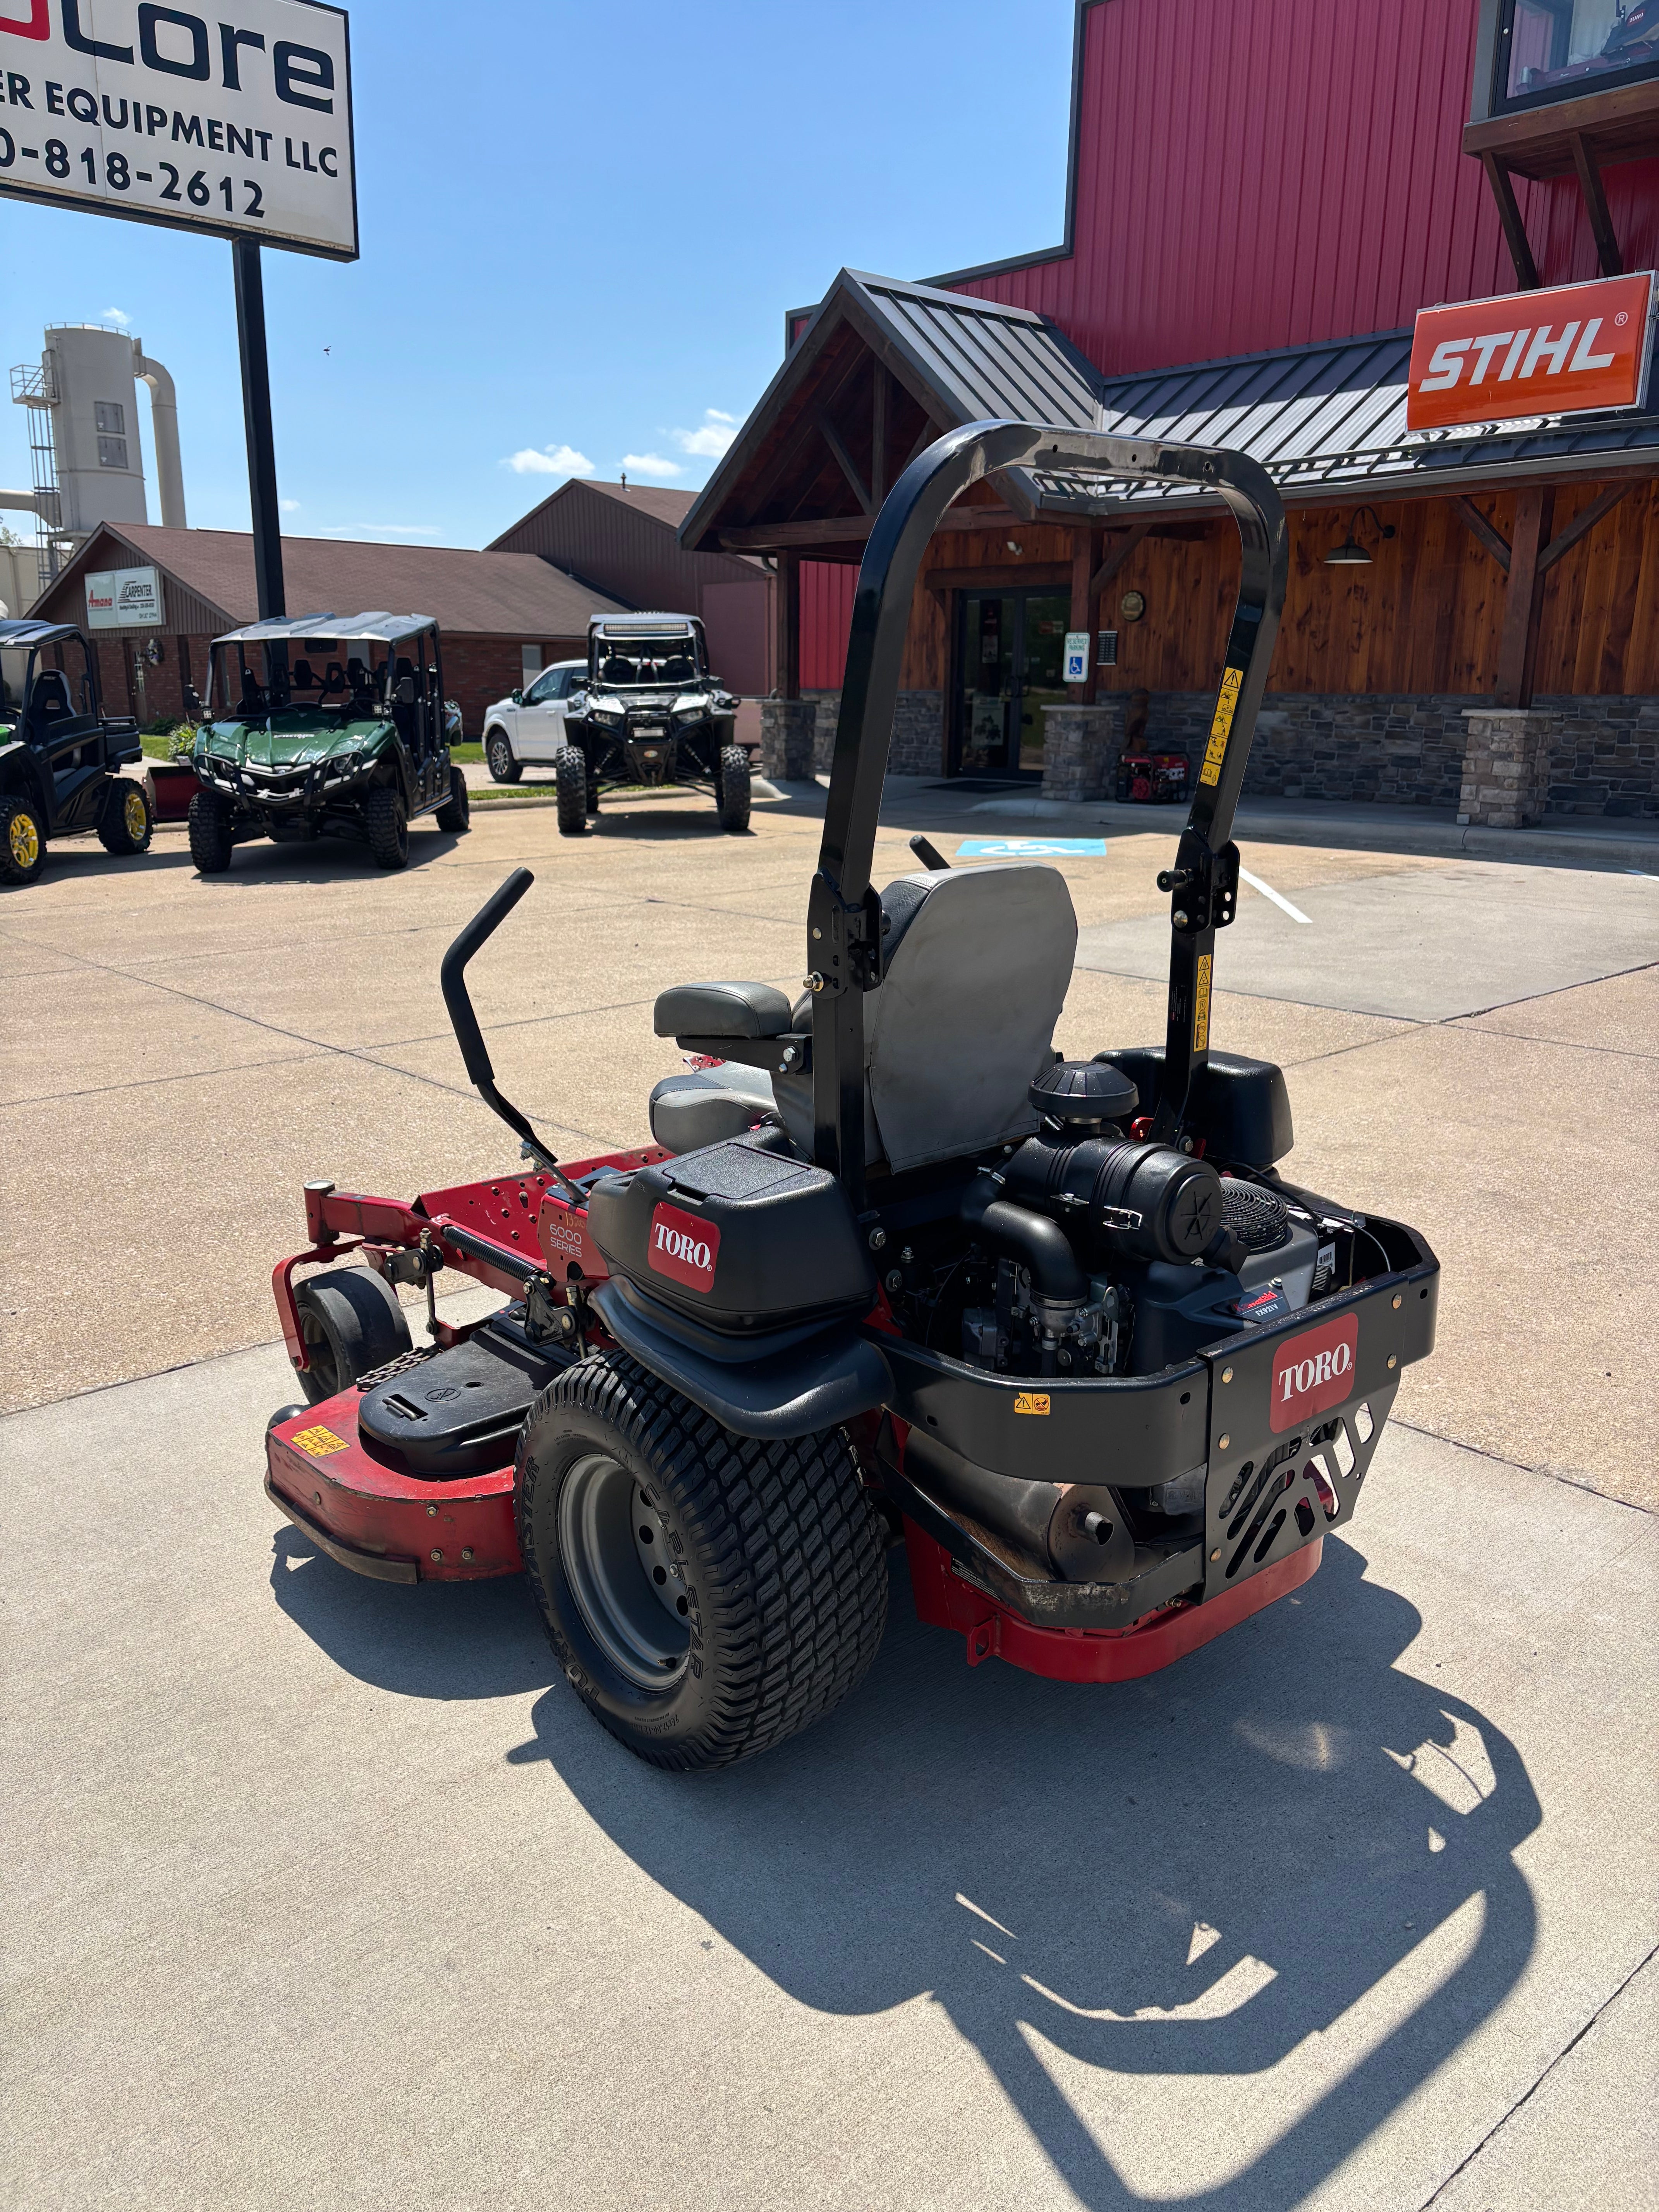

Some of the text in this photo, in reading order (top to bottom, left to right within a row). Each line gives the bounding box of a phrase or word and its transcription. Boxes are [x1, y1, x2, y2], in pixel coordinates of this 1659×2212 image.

[1629, 12, 1644, 23] TORO
[45, 80, 273, 162] EQUIPMENT
[285, 136, 338, 178] LLC
[1419, 317, 1615, 393] STIHL
[88, 589, 112, 608] Amana
[125, 584, 152, 598] CARPENTER
[550, 1223, 582, 1245] 6000
[550, 1237, 582, 1257] SERIES
[655, 1223, 711, 1269] TORO
[1233, 1290, 1278, 1312] Kawasaki
[1255, 1303, 1279, 1317] FX921V
[1279, 1343, 1350, 1402] TORO
[520, 1455, 550, 1611] MASTER
